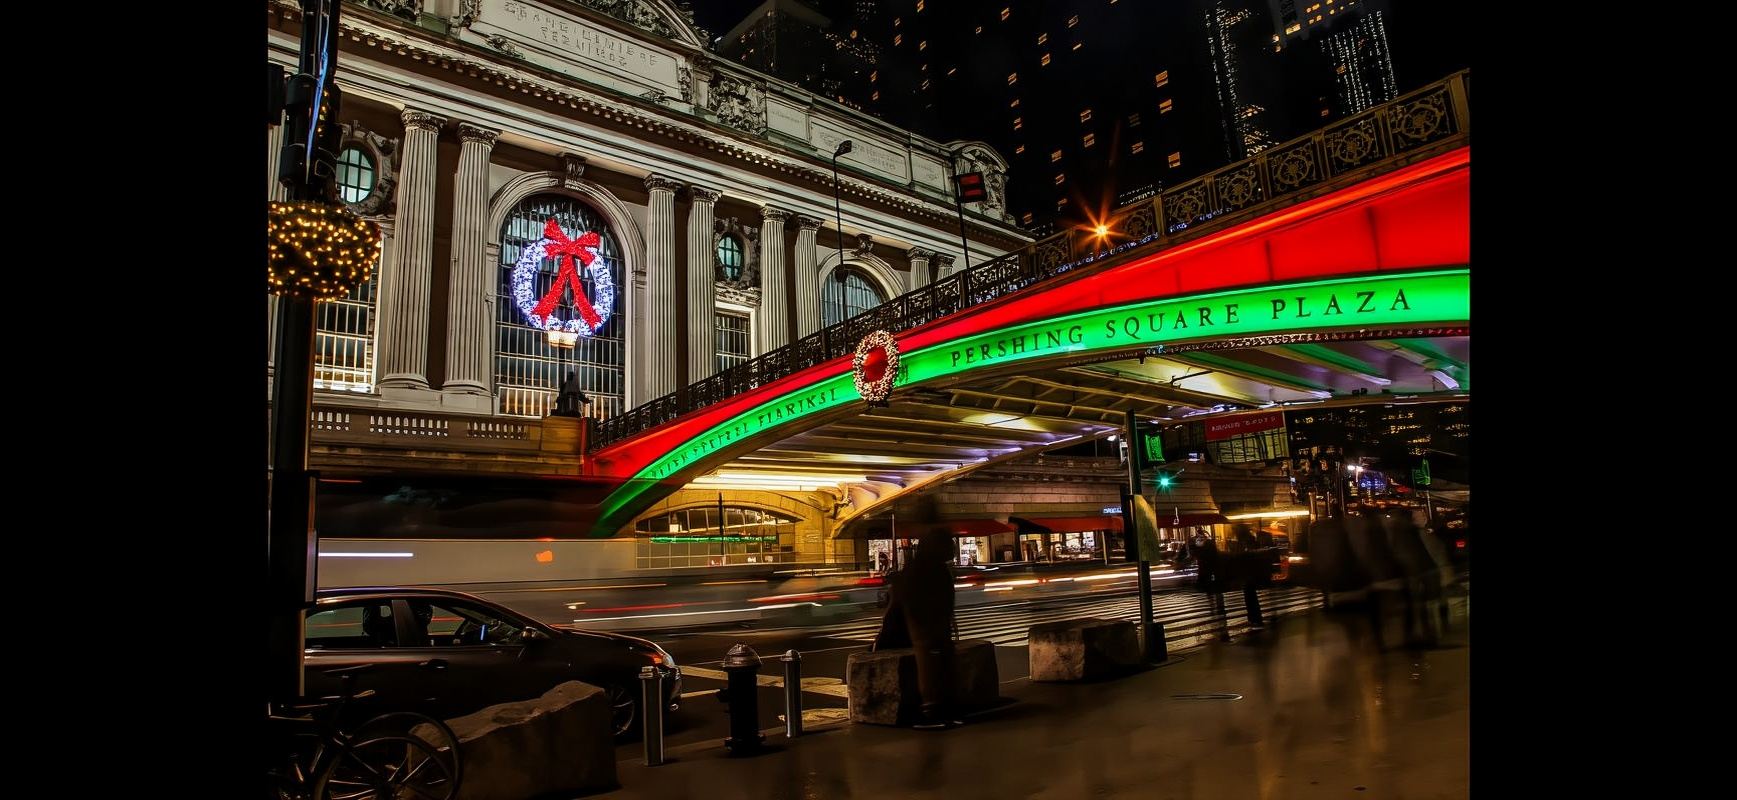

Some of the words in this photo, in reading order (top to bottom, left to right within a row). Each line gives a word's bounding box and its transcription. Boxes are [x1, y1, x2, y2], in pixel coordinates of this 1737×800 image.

[951, 325, 1083, 367] PERSHING
[1105, 303, 1240, 340] SQUARE
[1270, 288, 1411, 320] PLAZA
